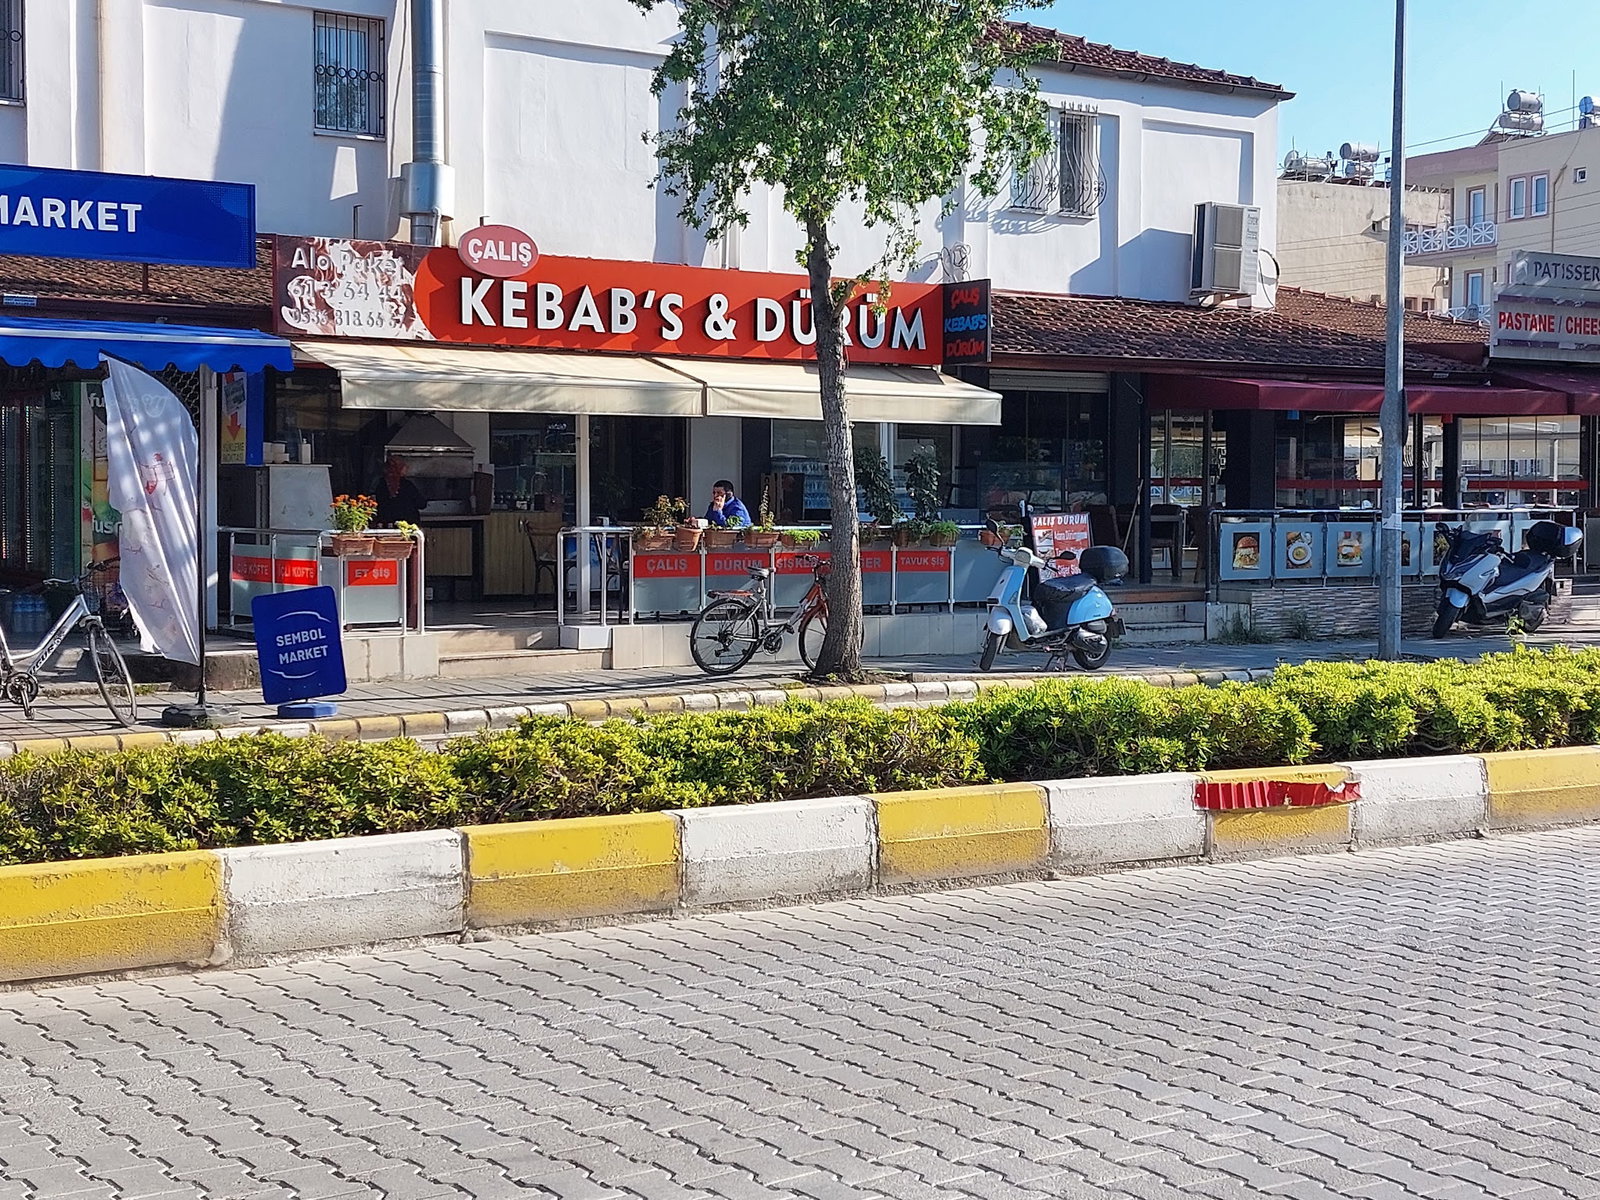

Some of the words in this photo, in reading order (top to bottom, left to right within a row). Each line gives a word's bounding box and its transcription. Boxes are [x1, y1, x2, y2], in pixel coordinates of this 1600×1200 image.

[291, 247, 329, 270] Alo
[468, 238, 532, 266] ÇALIŞ
[461, 276, 684, 341] KEBAB'S
[705, 293, 737, 341] &
[1498, 312, 1555, 333] PASTANE
[946, 338, 985, 357] DÜRÜM
[646, 559, 688, 573] ÇALIŞ
[901, 557, 929, 566] TAVUK
[355, 568, 369, 578] ET
[276, 628, 326, 647] SEMBOL
[279, 645, 328, 665] MARKET
